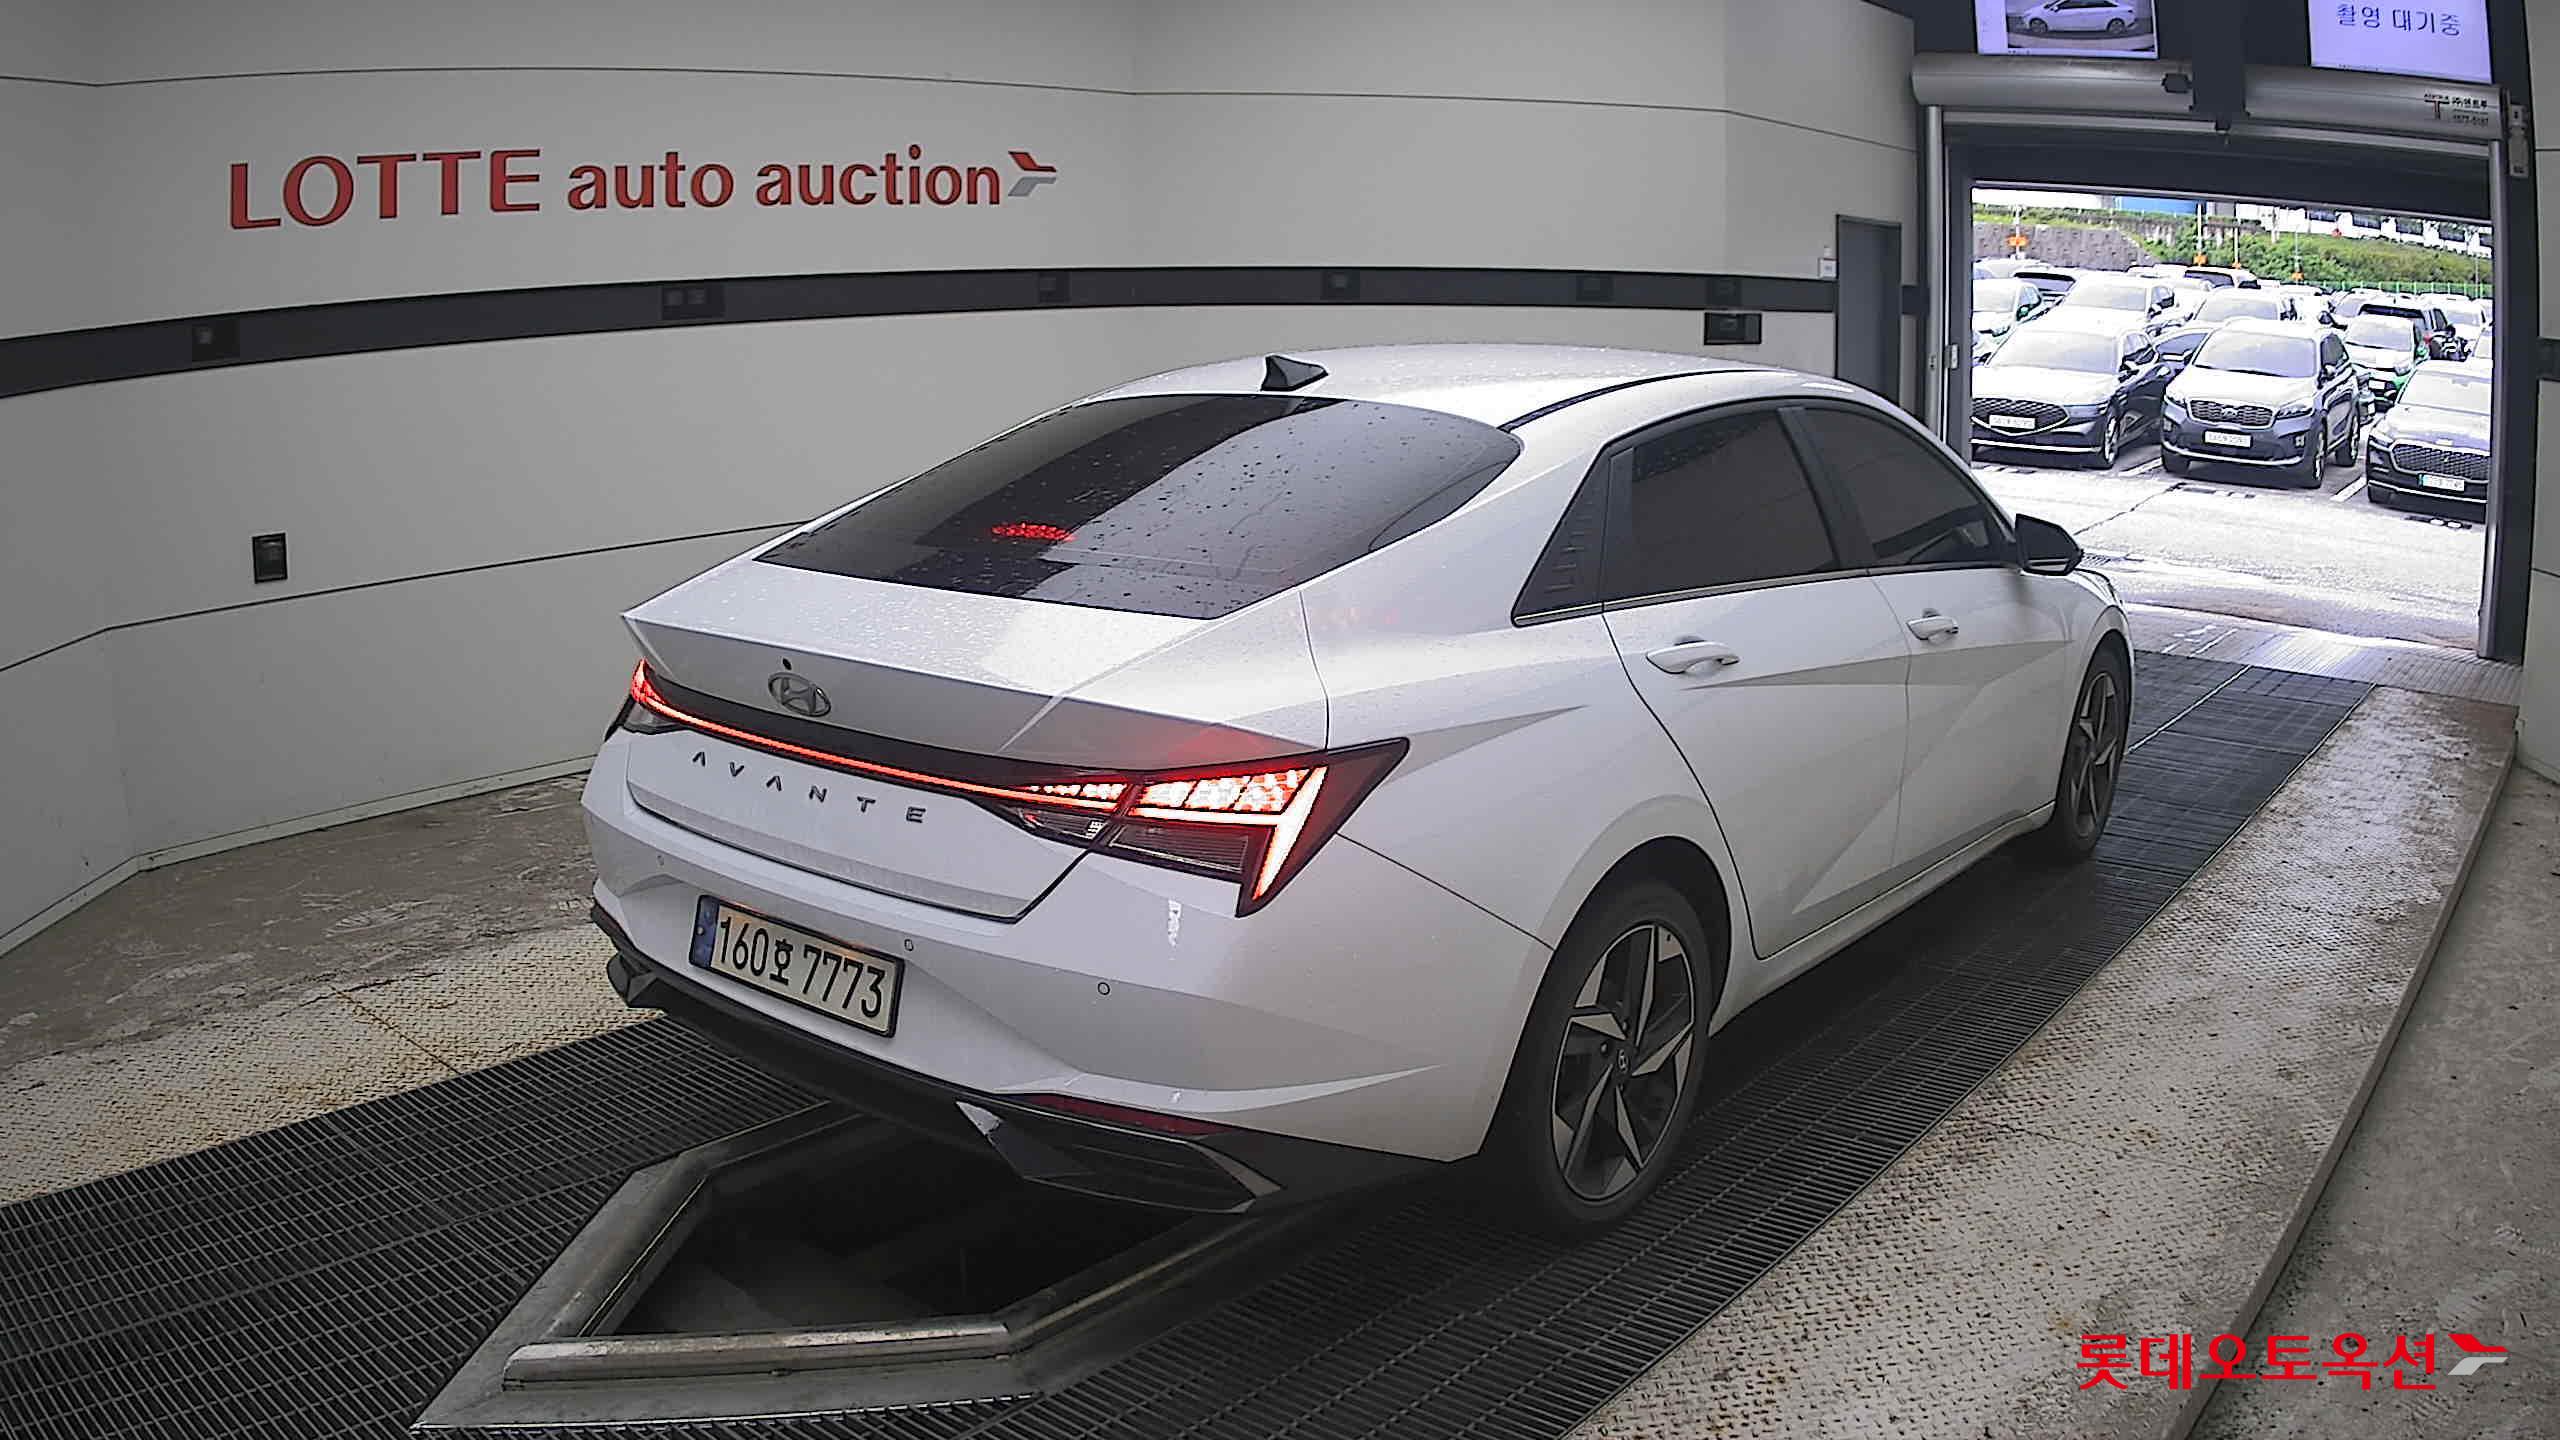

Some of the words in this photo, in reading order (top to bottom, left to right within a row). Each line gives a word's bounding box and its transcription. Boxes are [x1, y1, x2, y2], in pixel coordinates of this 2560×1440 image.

[2337, 3, 2381, 29] 촬영
[2392, 9, 2461, 37] 대기중
[230, 150, 539, 229] LOTTE
[568, 152, 735, 210] auto
[756, 146, 1001, 206] auction
[691, 750, 927, 825] AVANTE
[719, 915, 795, 988] 160호
[802, 942, 887, 1019] 7773
